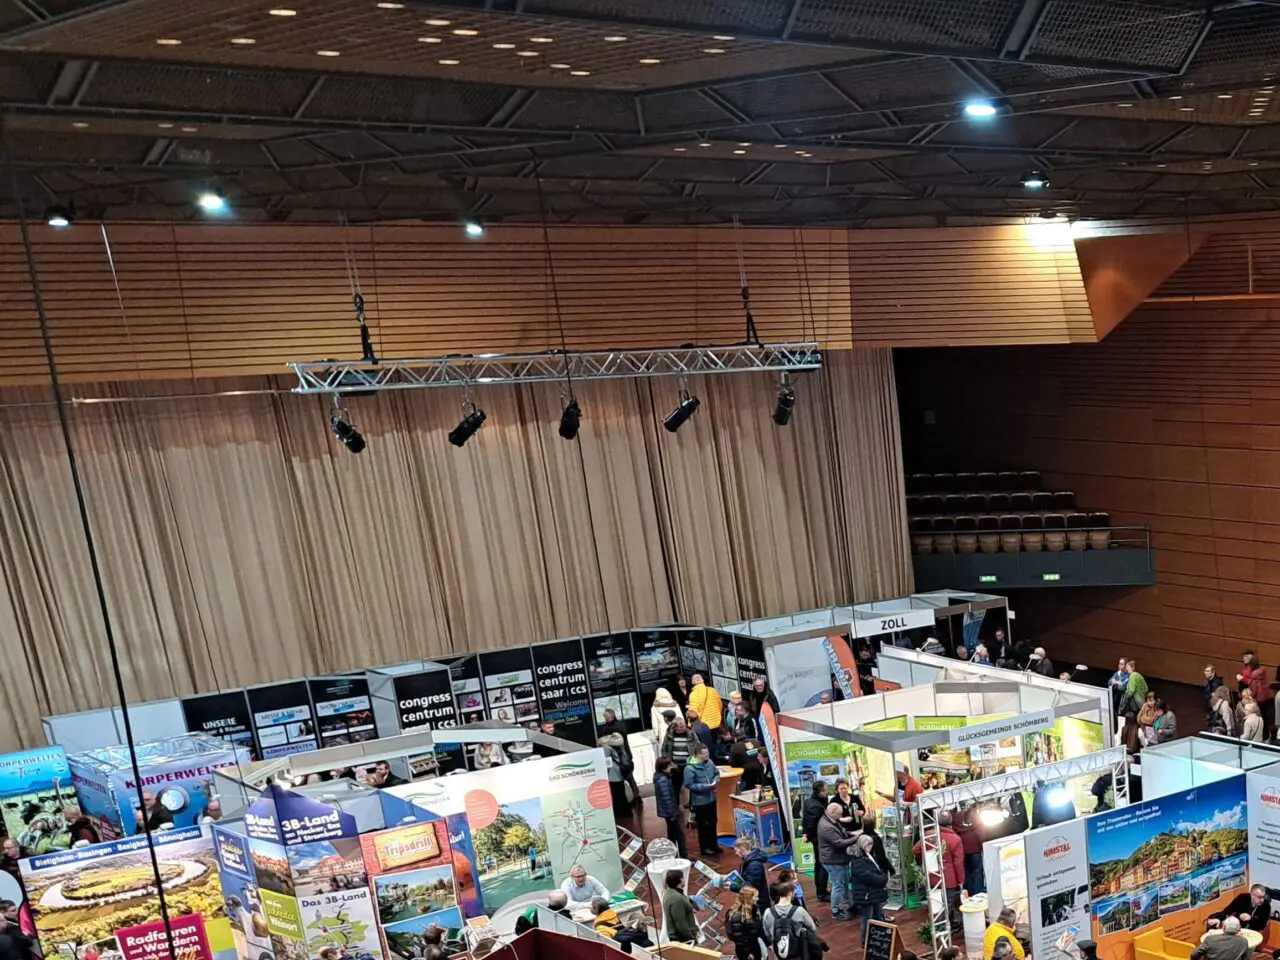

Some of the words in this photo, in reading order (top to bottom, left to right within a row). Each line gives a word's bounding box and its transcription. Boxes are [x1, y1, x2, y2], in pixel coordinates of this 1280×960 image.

[881, 617, 907, 630] ZOLL
[537, 661, 583, 675] congress
[738, 657, 765, 670] congress
[539, 673, 585, 687] centrum
[739, 669, 767, 681] centrum
[541, 688, 564, 700] saar
[570, 685, 587, 695] ccs
[741, 682, 754, 691] saa
[400, 692, 451, 709] congress
[402, 706, 454, 723] centrum
[202, 717, 236, 729] UNSERE
[438, 719, 457, 730] ccs
[957, 724, 1012, 743] GLÜCKSGEMEINDE
[1013, 716, 1049, 732] SCHÖMBERG
[281, 810, 339, 831] 3B-Land
[117, 839, 147, 851] Besighei
[384, 836, 432, 857] Tripsdrill
[302, 898, 321, 908] Das
[325, 891, 367, 904] 3B-Land
